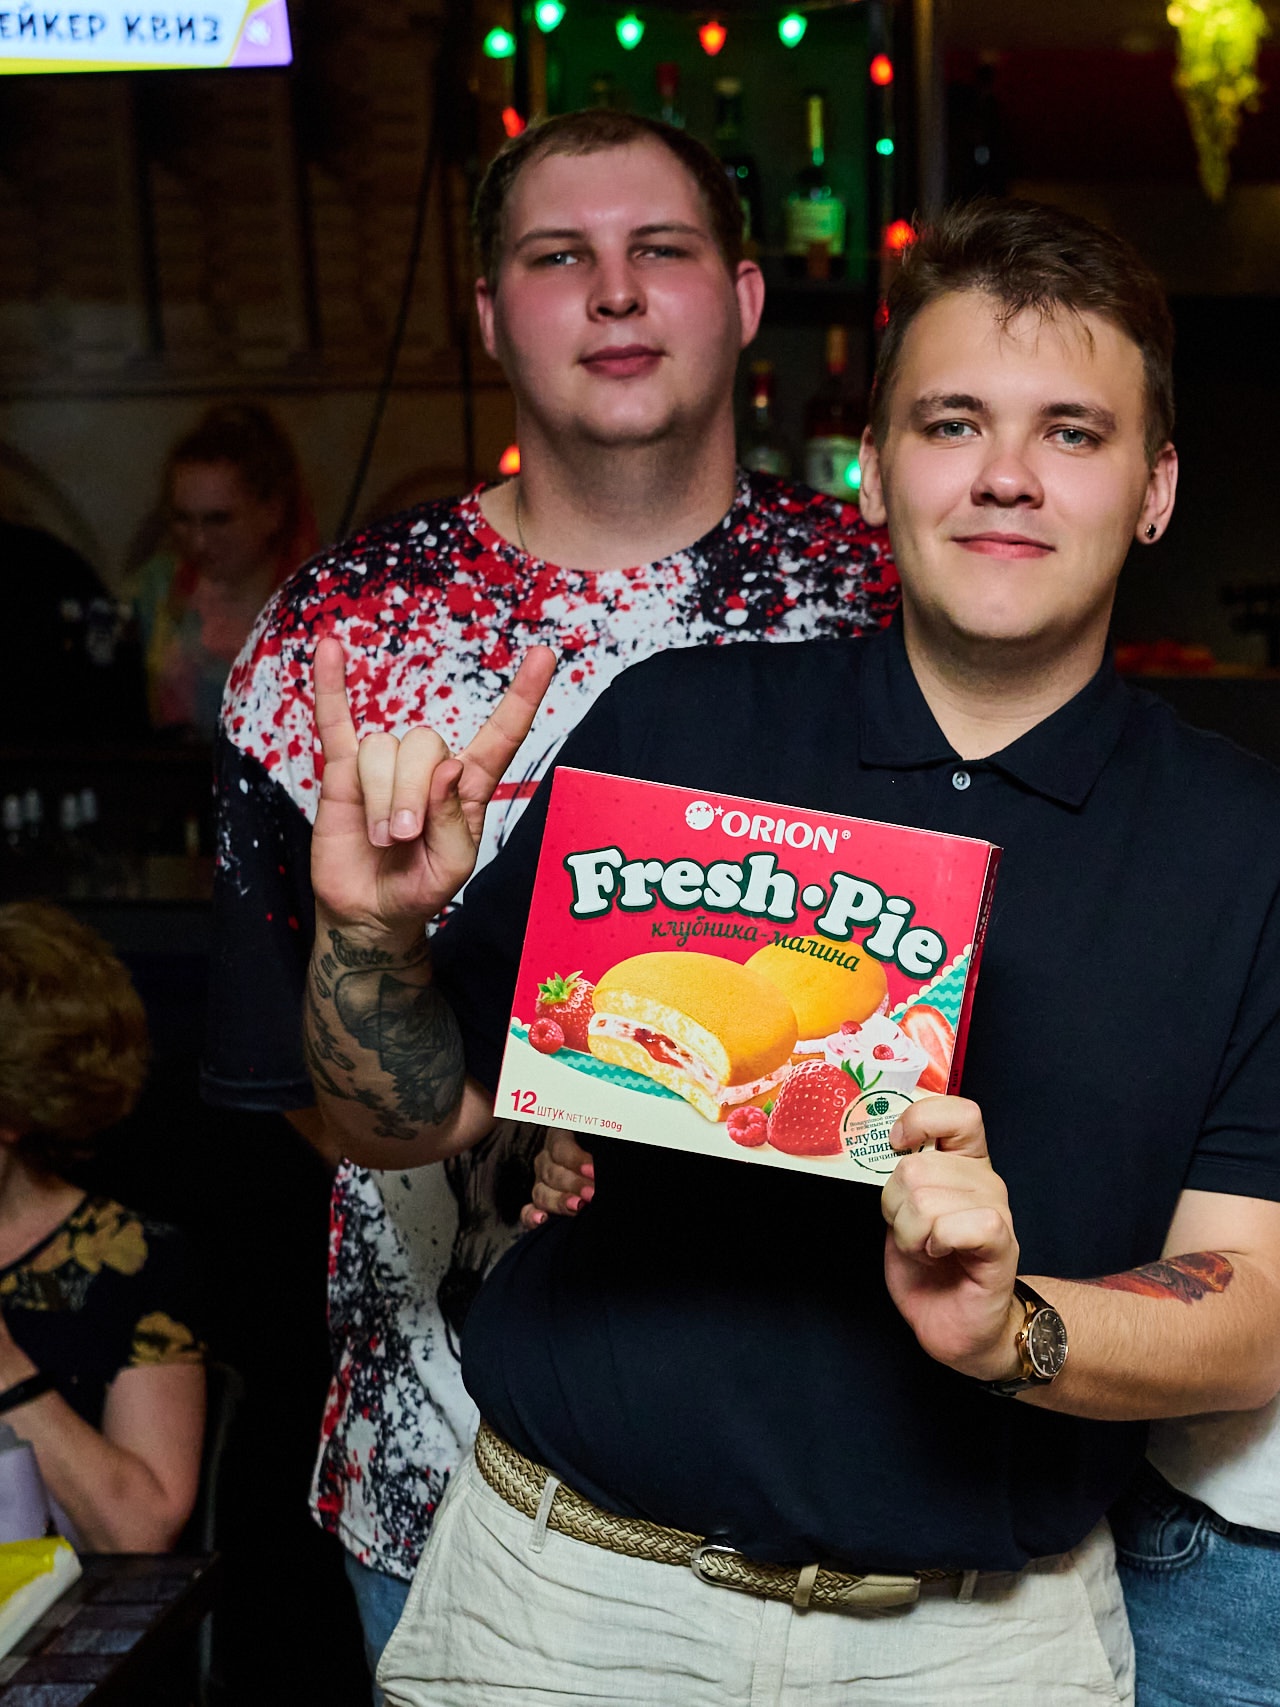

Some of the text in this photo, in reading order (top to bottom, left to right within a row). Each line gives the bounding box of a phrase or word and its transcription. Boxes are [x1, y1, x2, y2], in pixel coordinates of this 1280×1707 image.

[124, 15, 219, 42] КВИЗ
[510, 1089, 537, 1115] 12
[566, 1112, 583, 1123] NET
[584, 1116, 599, 1126] WT
[599, 1119, 623, 1132] 300g
[849, 1143, 893, 1159] малин
